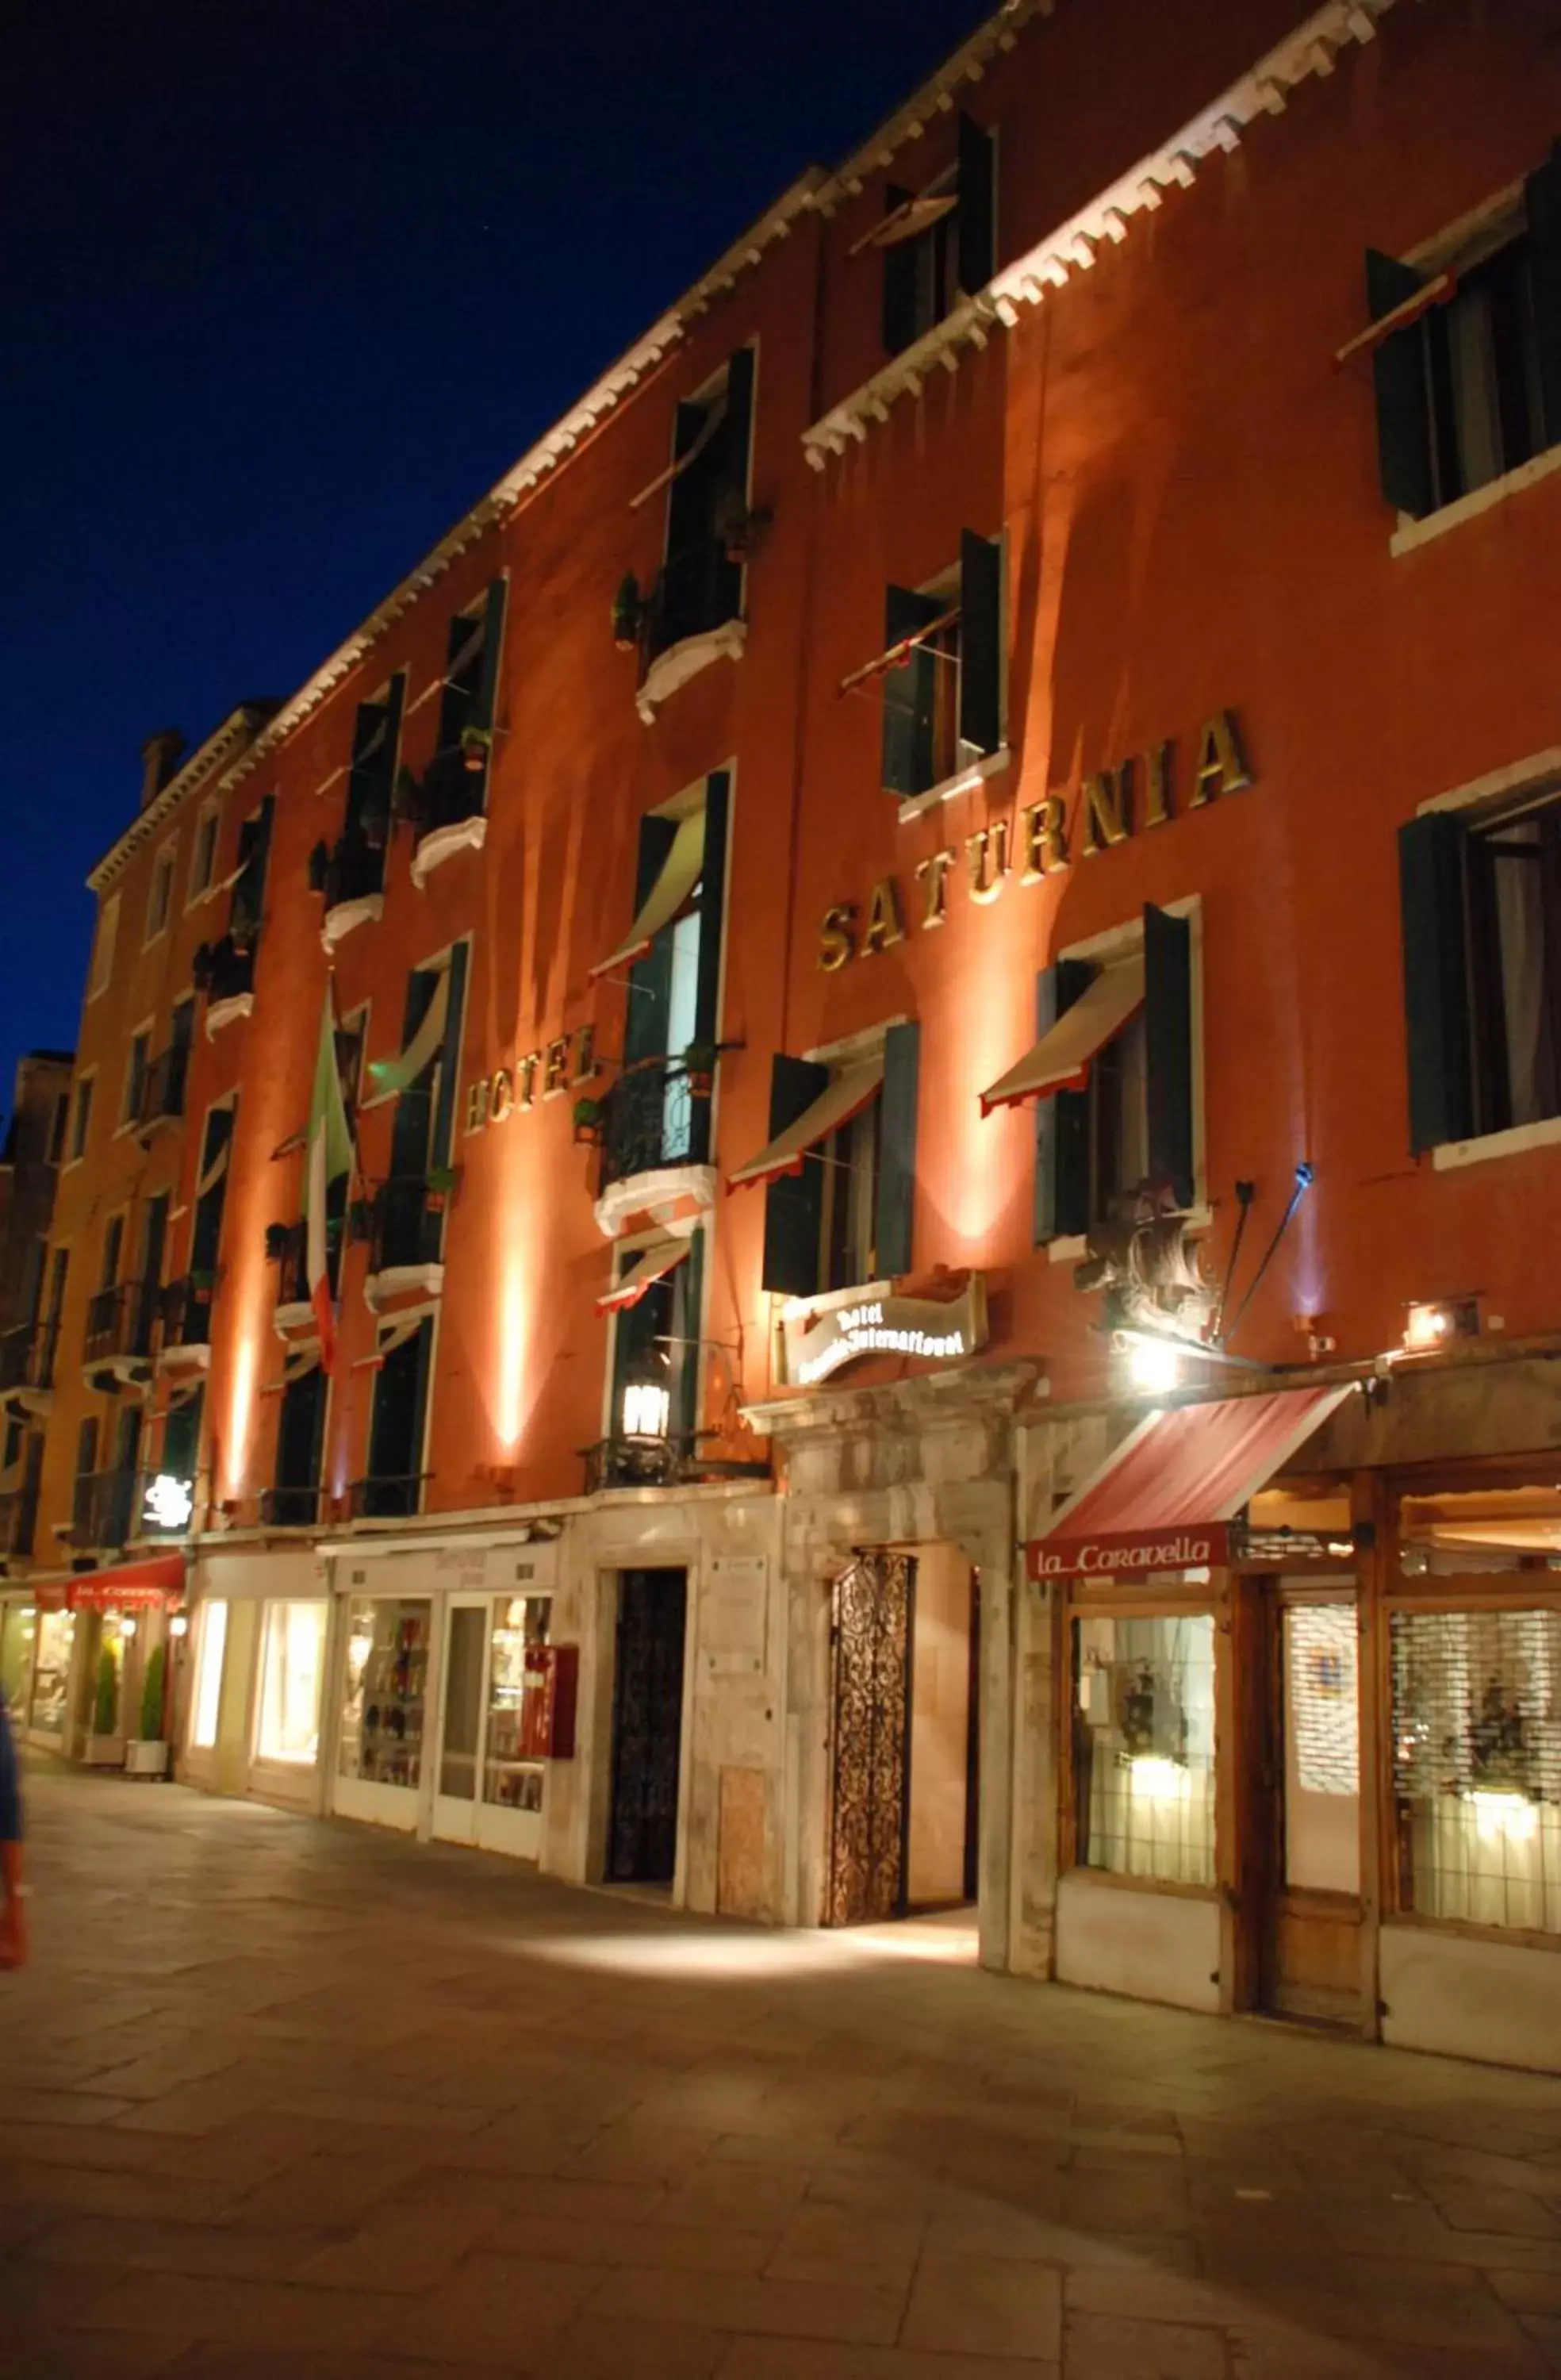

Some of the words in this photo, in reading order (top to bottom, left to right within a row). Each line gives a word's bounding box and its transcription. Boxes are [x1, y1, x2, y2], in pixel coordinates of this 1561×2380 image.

[816, 708, 1256, 973] SATURNIA
[463, 1023, 600, 1138] HOTEL
[1075, 1536, 1210, 1572] Caravella
